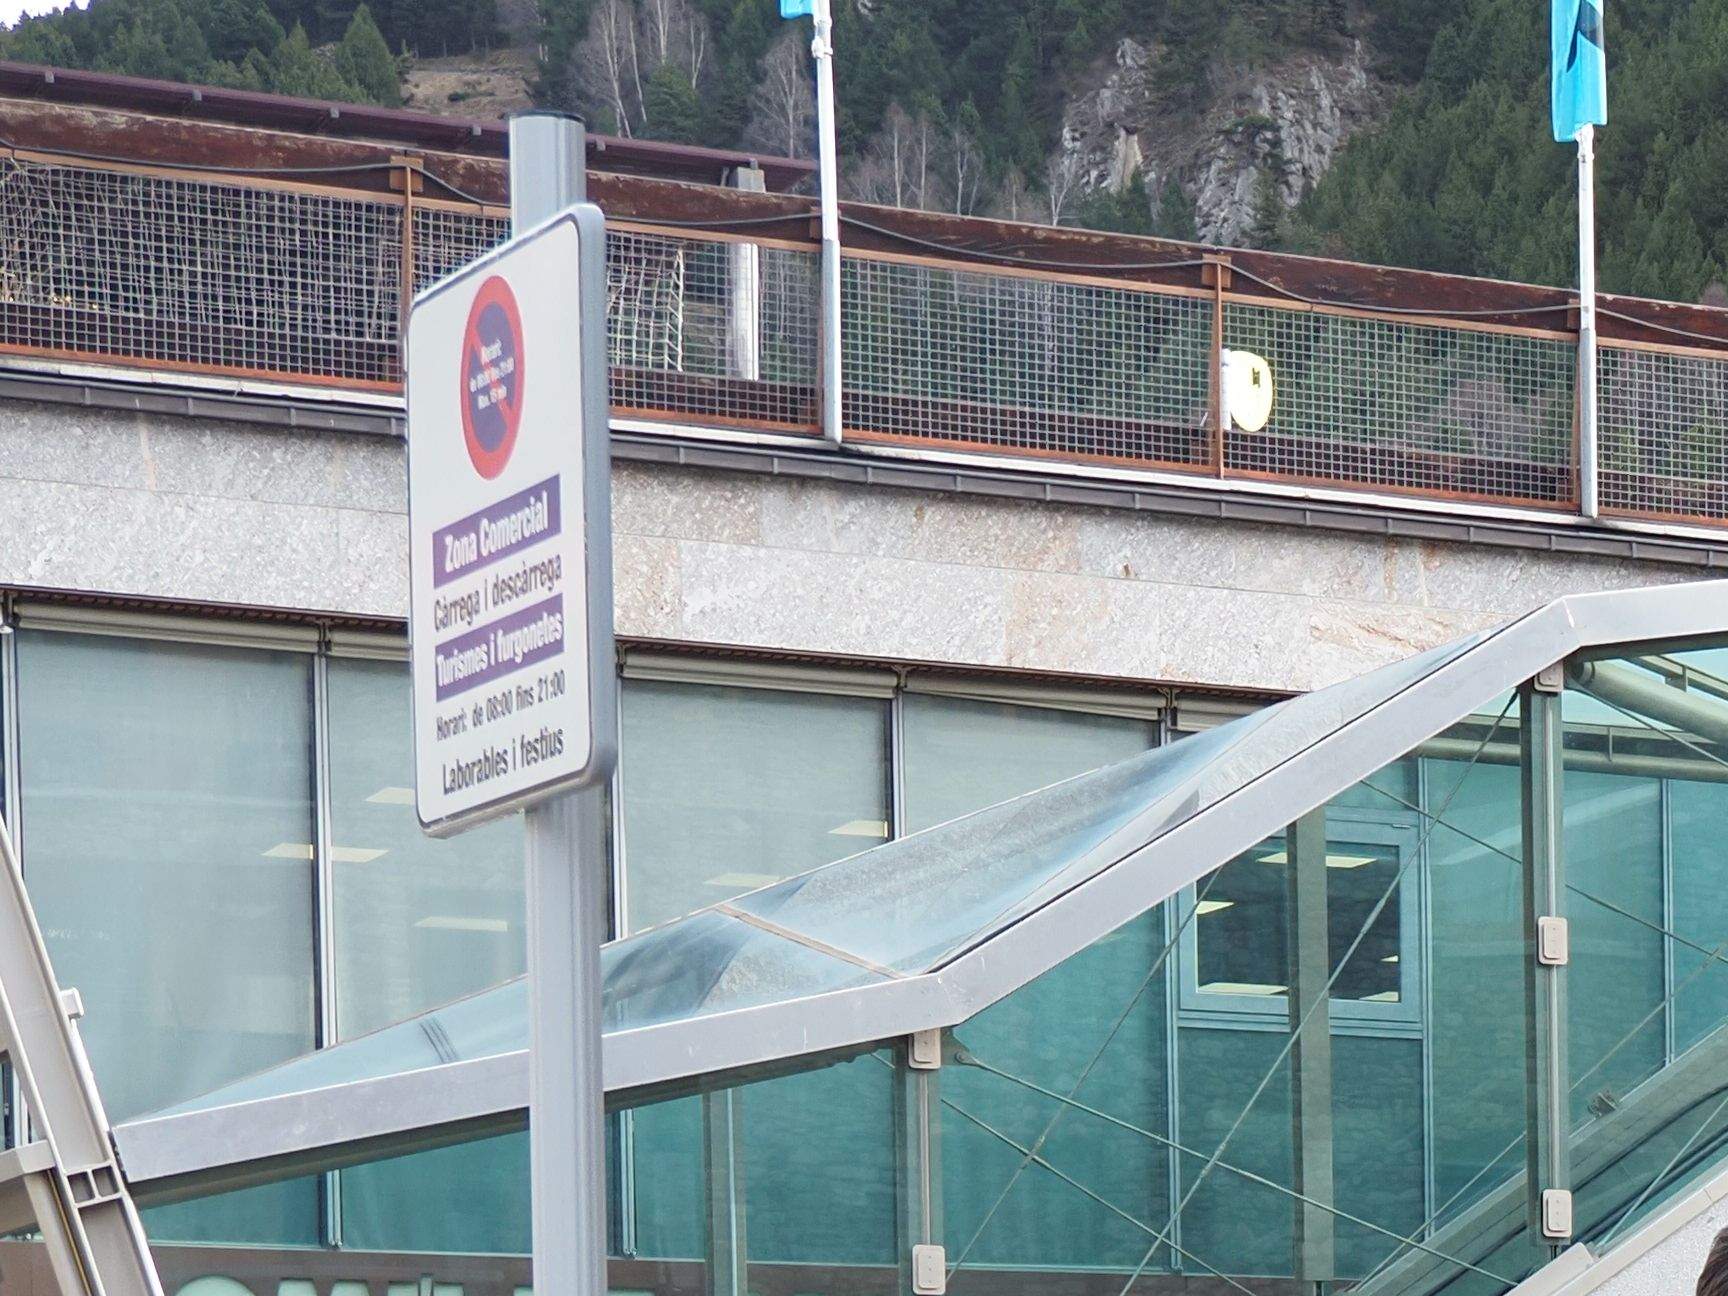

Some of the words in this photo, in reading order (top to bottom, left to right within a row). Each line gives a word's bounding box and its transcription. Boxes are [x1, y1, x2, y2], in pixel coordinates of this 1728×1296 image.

[444, 532, 478, 573] Zona
[479, 489, 549, 557] Comercial
[436, 643, 489, 687] Turismes
[489, 633, 495, 666] i
[496, 611, 563, 664] furgonetes
[472, 702, 484, 727] de
[537, 669, 565, 703] 21:00
[443, 746, 509, 795] Laborables
[512, 738, 517, 771] i
[520, 726, 564, 768] festius
